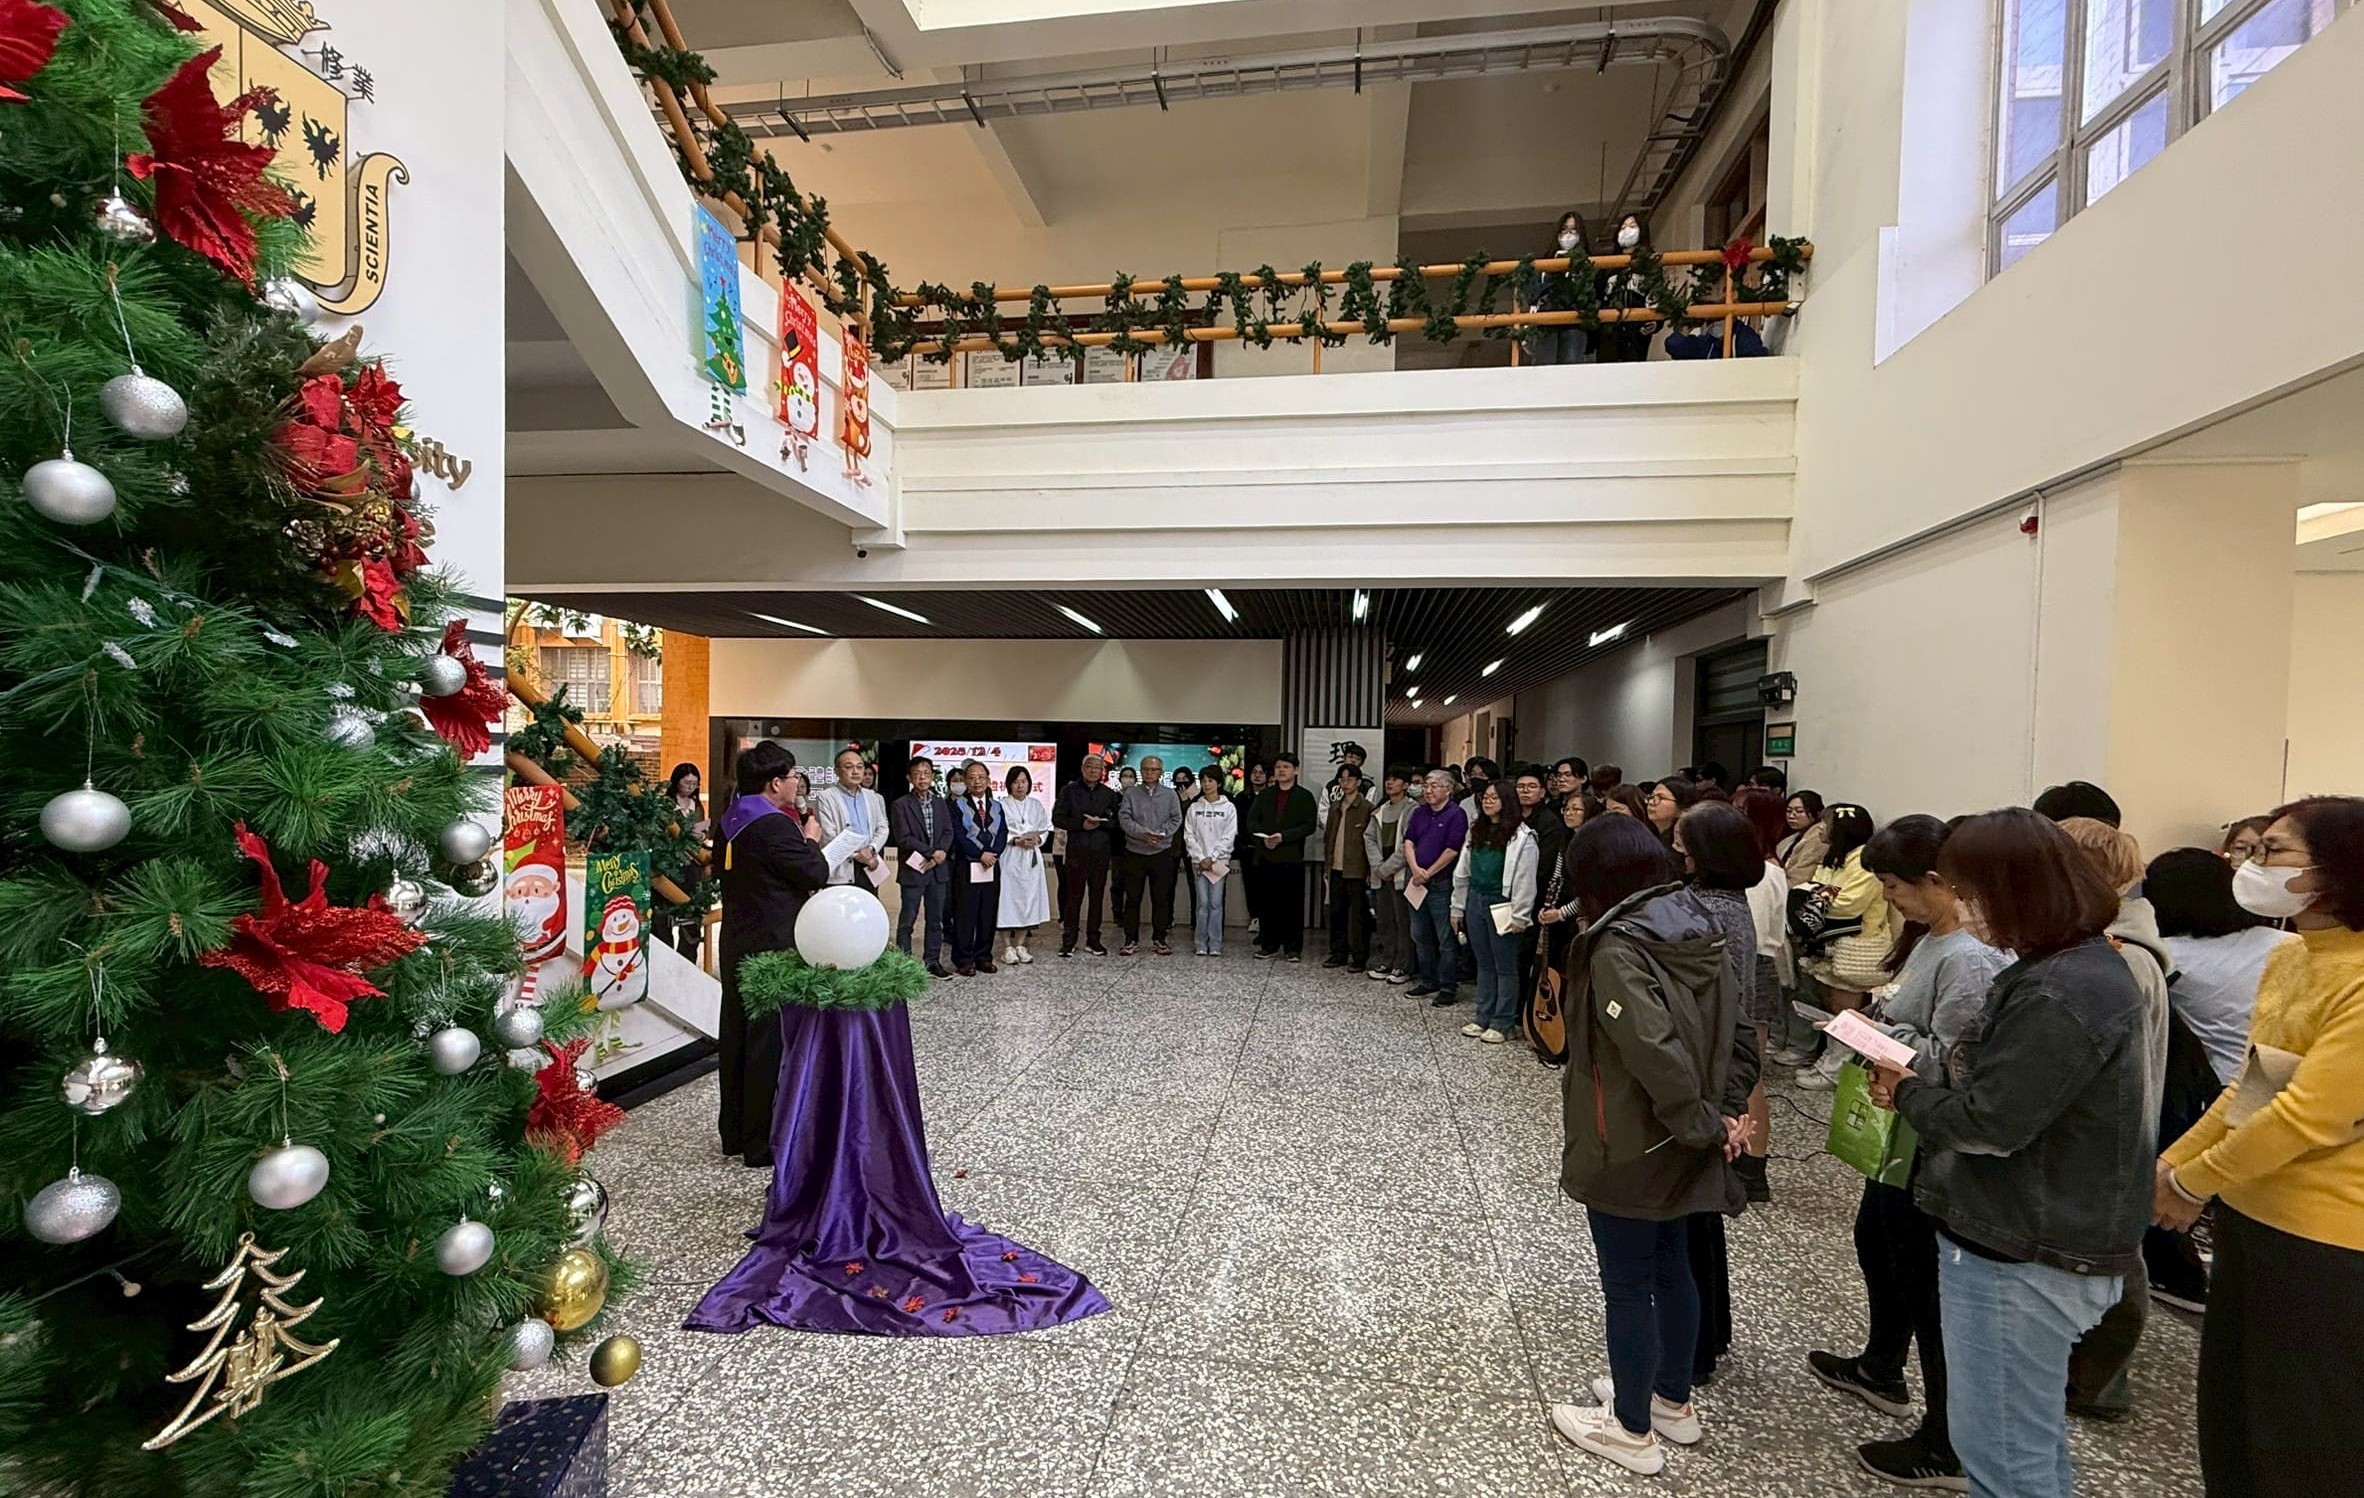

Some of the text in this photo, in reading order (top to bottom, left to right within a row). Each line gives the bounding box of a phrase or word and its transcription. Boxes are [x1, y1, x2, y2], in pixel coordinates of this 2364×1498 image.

[365, 184, 379, 284] SCIENTIA
[504, 787, 543, 810] Merry
[504, 803, 557, 834] hristmas
[596, 853, 622, 873] Merry
[602, 862, 640, 894] Christmas
